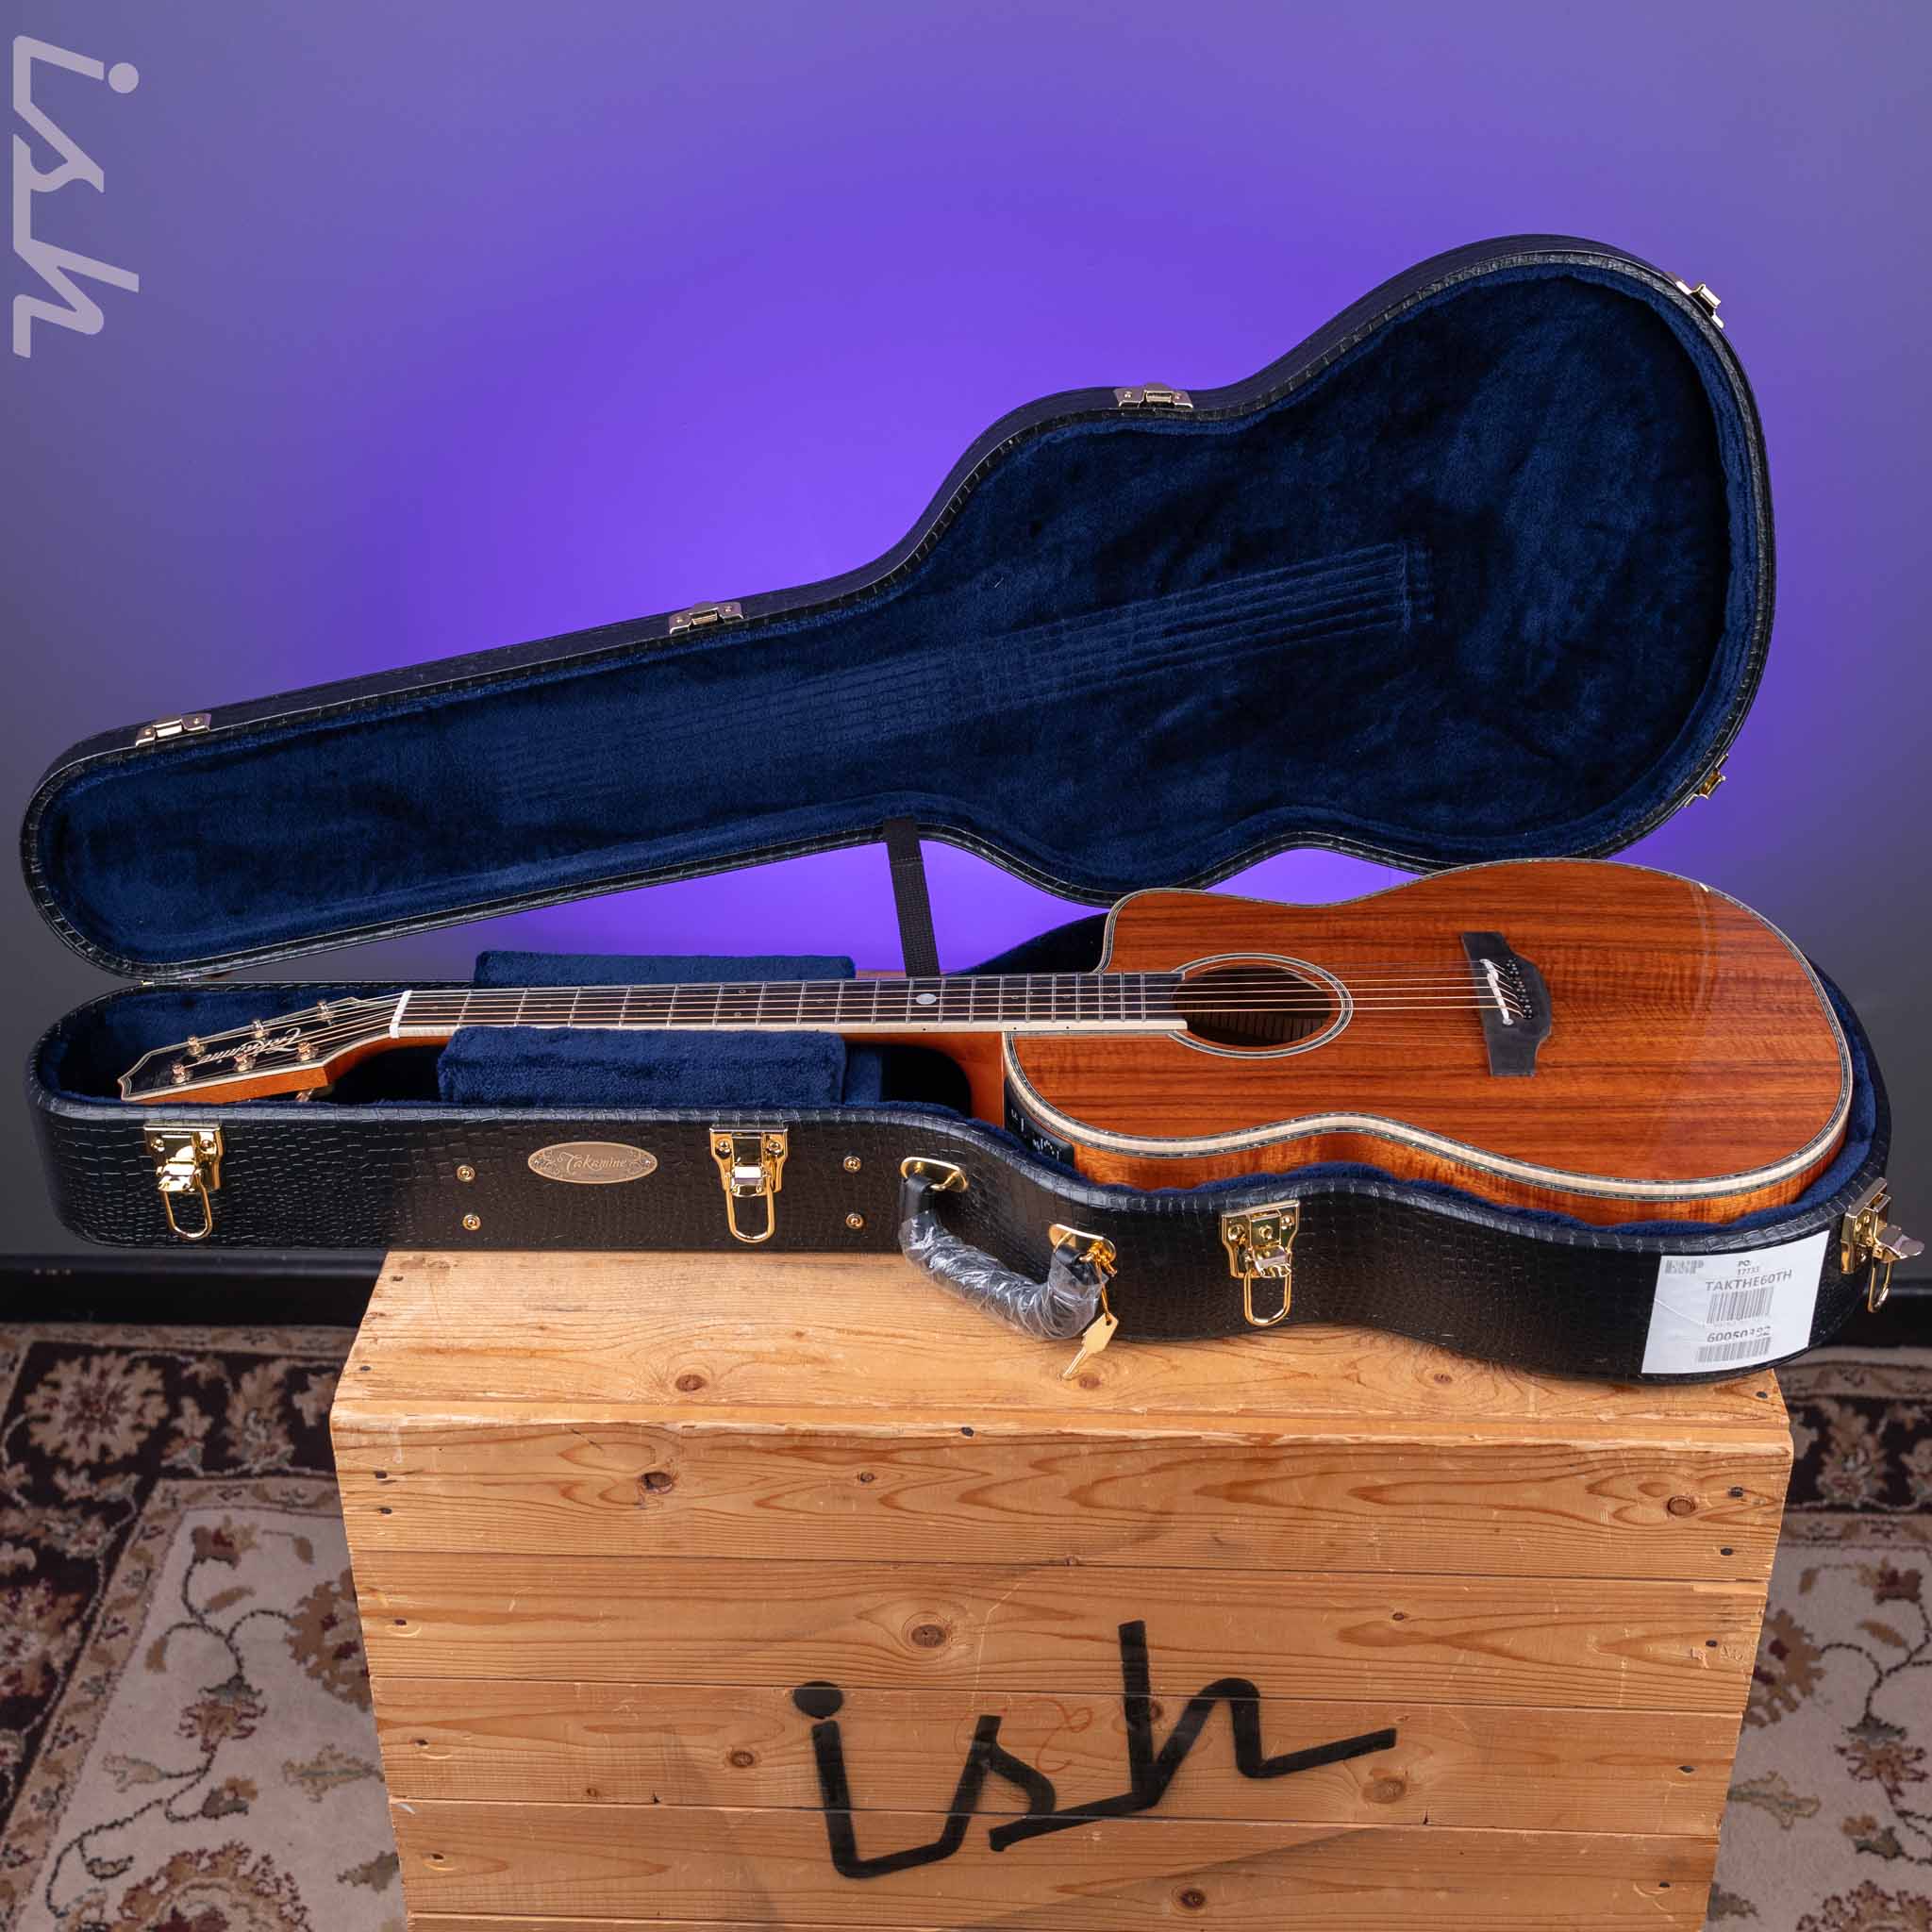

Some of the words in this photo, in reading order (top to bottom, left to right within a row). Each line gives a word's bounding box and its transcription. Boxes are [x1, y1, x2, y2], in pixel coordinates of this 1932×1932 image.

[558, 1151, 627, 1175] Takamine
[1705, 1269, 1792, 1291] TAKTHE60TH
[792, 1620, 1397, 1878] ish
